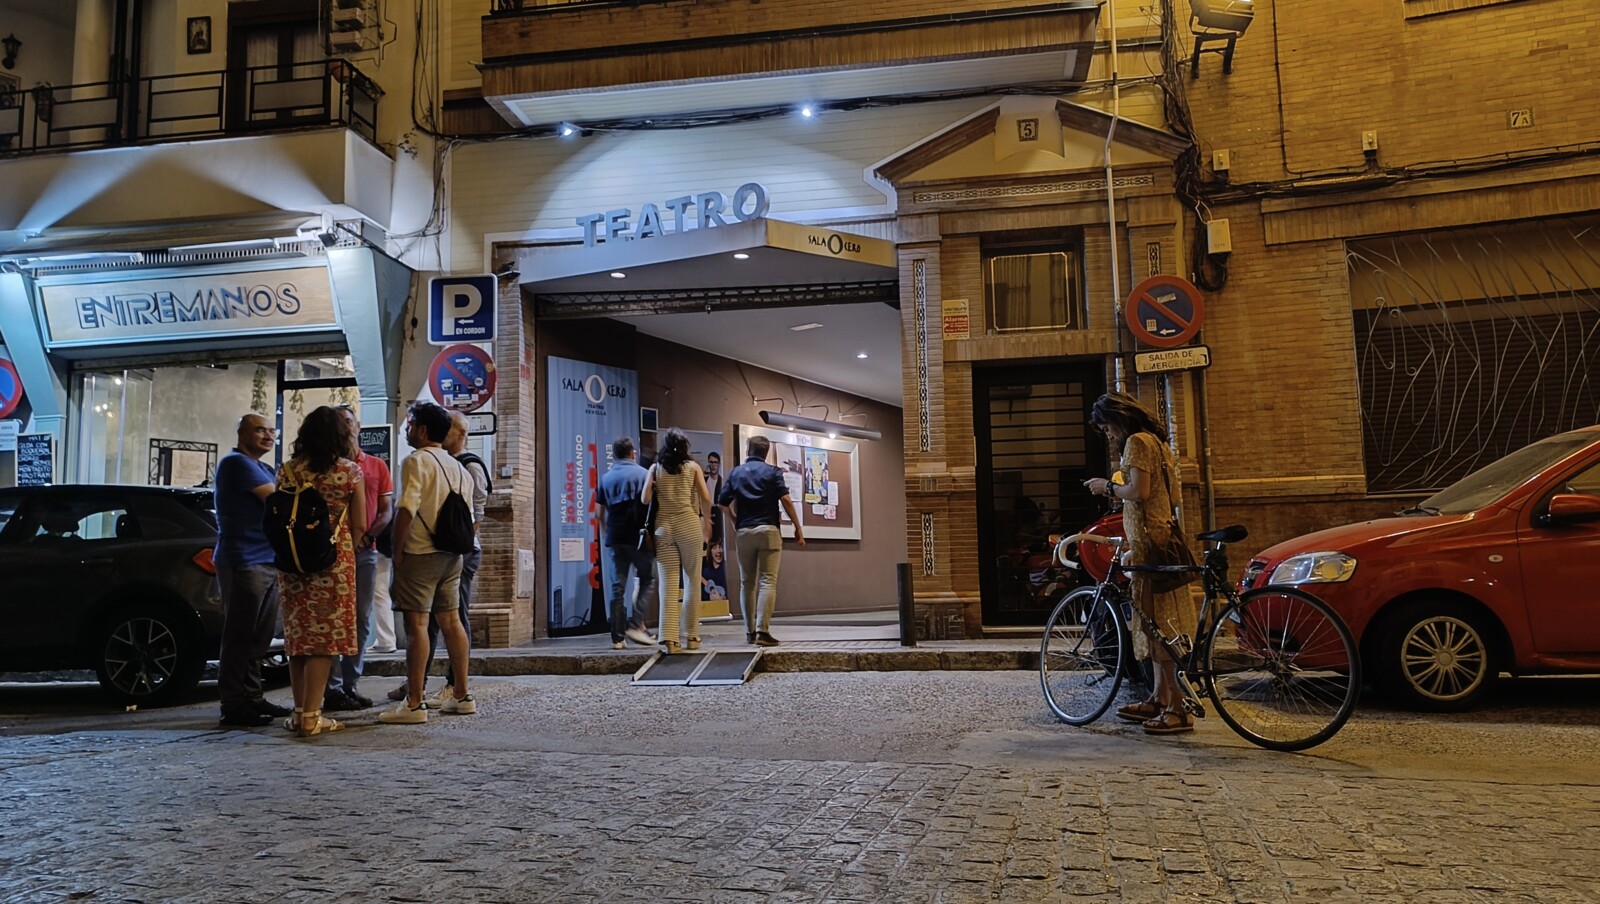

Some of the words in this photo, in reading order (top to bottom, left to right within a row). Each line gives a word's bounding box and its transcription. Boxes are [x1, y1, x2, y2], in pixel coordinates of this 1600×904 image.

[1023, 123, 1033, 137] 5
[576, 182, 770, 248] TEATRO
[808, 234, 827, 248] SALA
[844, 241, 861, 253] CERO
[75, 283, 301, 330] ENTREMANOS
[442, 284, 482, 336] P
[455, 327, 463, 335] EN
[1143, 358, 1202, 371] EMERGENCIA
[1148, 351, 1180, 362] SALIDA
[1181, 349, 1194, 358] DE
[562, 377, 584, 393] SALA
[607, 384, 627, 398] CERO
[605, 444, 613, 460] EN
[564, 462, 575, 503] AÑOS
[576, 434, 584, 524] PROGRAMANDO
[560, 493, 567, 504] DE
[567, 506, 576, 524] 20
